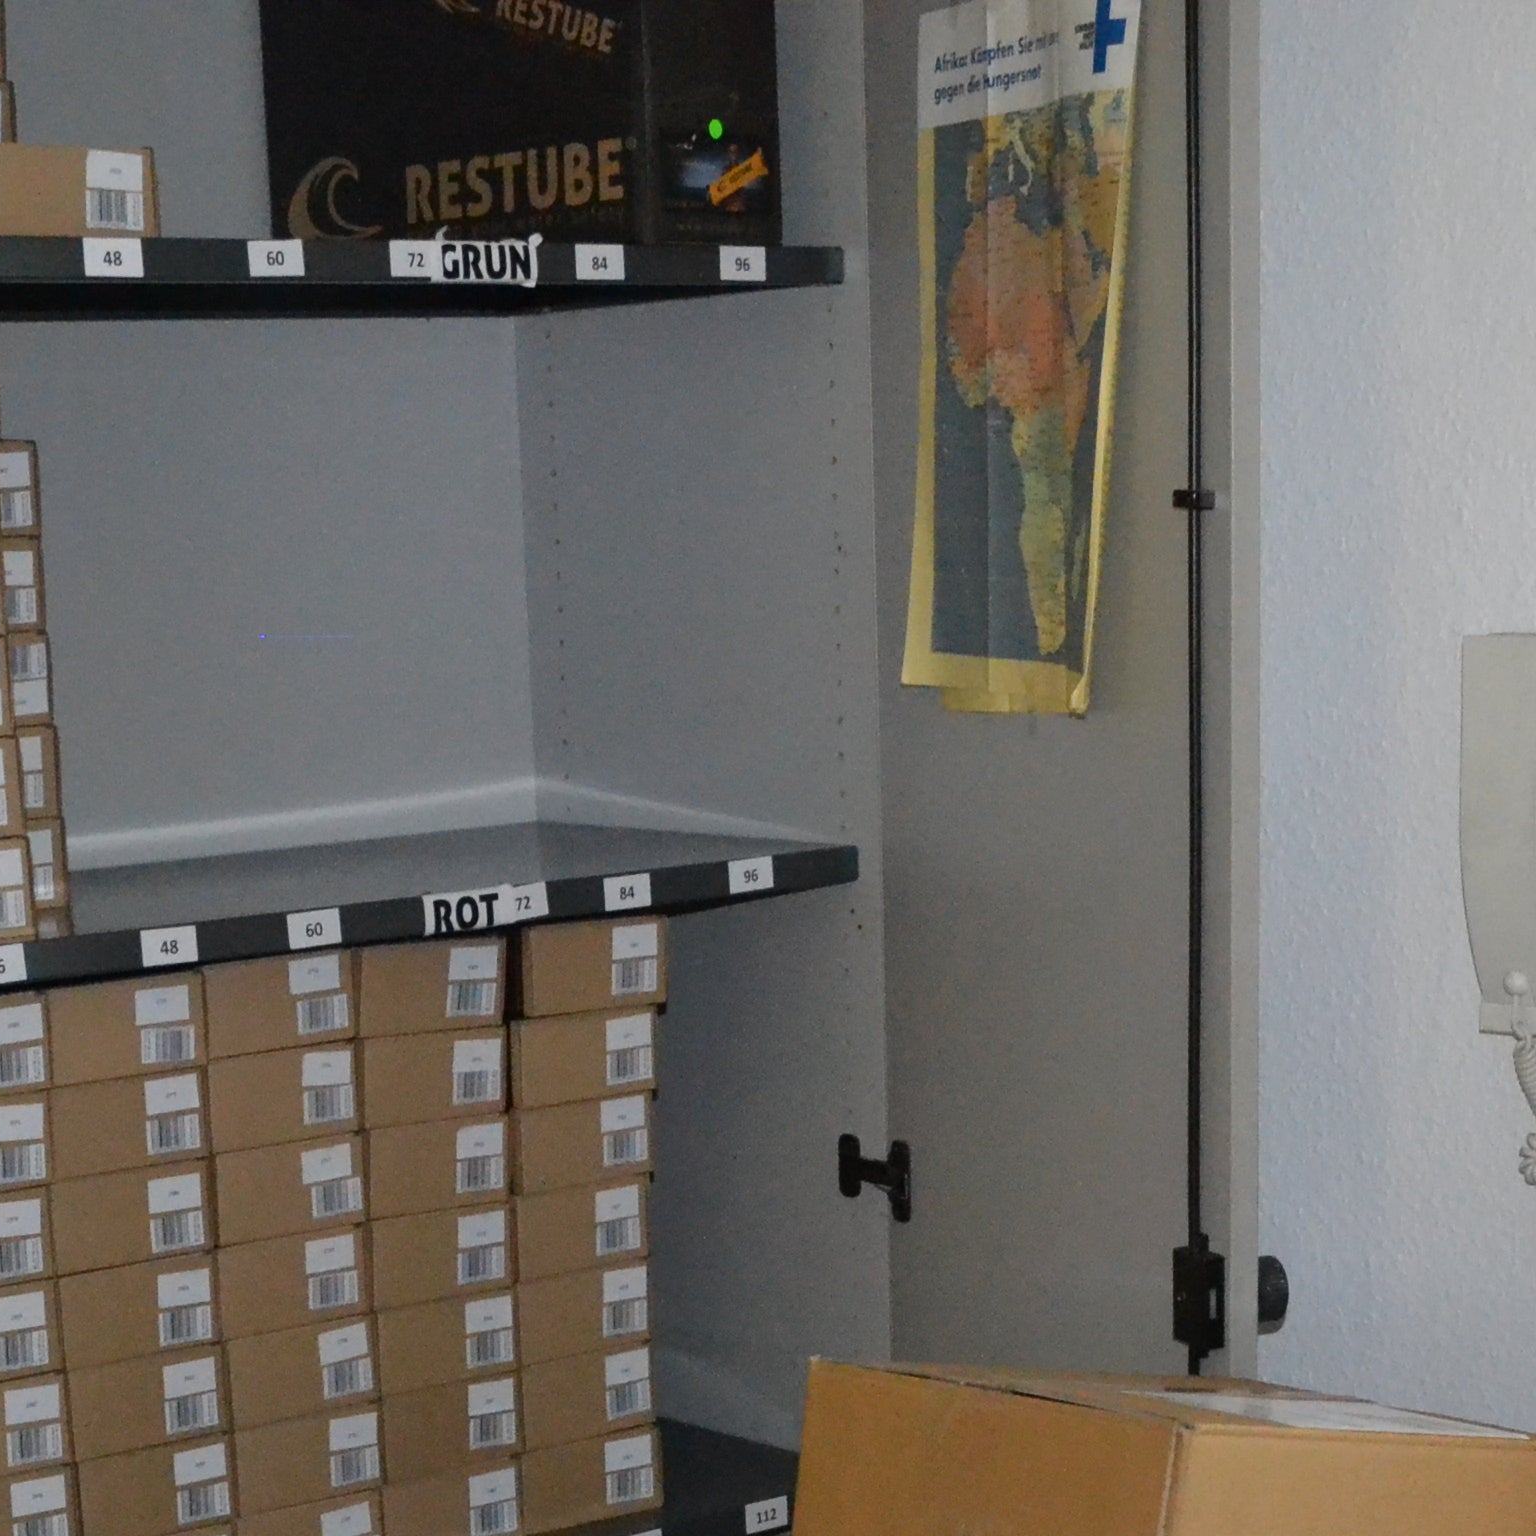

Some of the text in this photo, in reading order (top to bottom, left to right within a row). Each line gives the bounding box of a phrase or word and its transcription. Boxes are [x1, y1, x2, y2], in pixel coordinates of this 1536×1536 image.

[934, 63, 1043, 106] gegen die Hungersnot
[405, 137, 625, 225] RESTUBE
[101, 250, 123, 268] 48
[266, 251, 285, 267] 60
[407, 252, 425, 269] 72
[441, 243, 532, 280] GRUN
[591, 256, 608, 271] 84
[734, 257, 750, 272] 96
[742, 867, 759, 885] 96
[618, 885, 635, 902] 84
[514, 895, 532, 913] 72
[432, 892, 500, 935] ROT
[304, 921, 324, 938] 60
[159, 938, 179, 957] 48
[755, 1507, 778, 1525] 112
